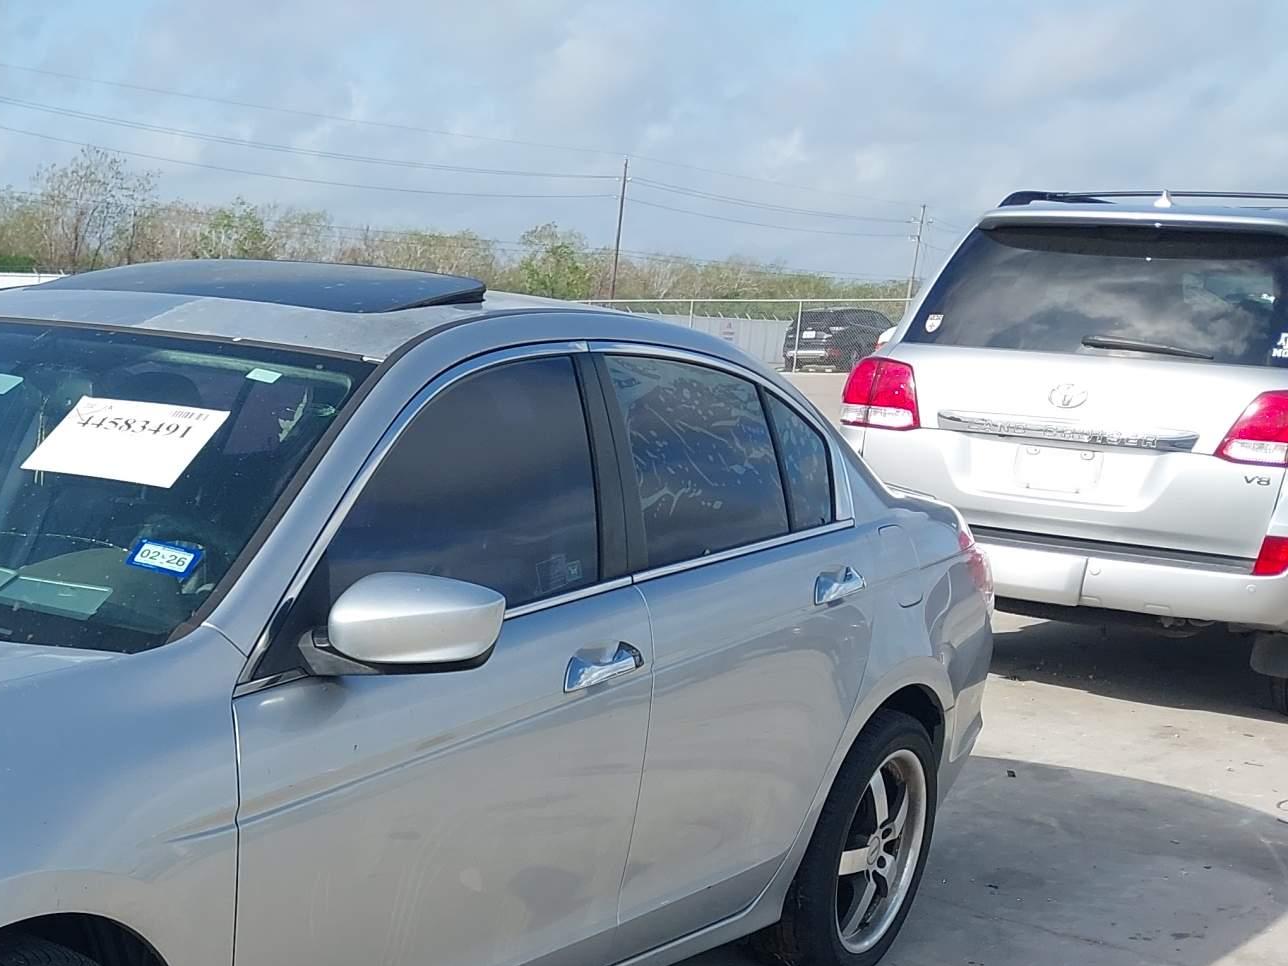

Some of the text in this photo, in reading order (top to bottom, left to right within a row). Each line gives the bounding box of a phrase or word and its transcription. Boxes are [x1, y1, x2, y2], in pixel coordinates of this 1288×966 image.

[77, 415, 192, 438] 44583491
[967, 418, 1026, 435] LAND
[1244, 475, 1271, 486] V8
